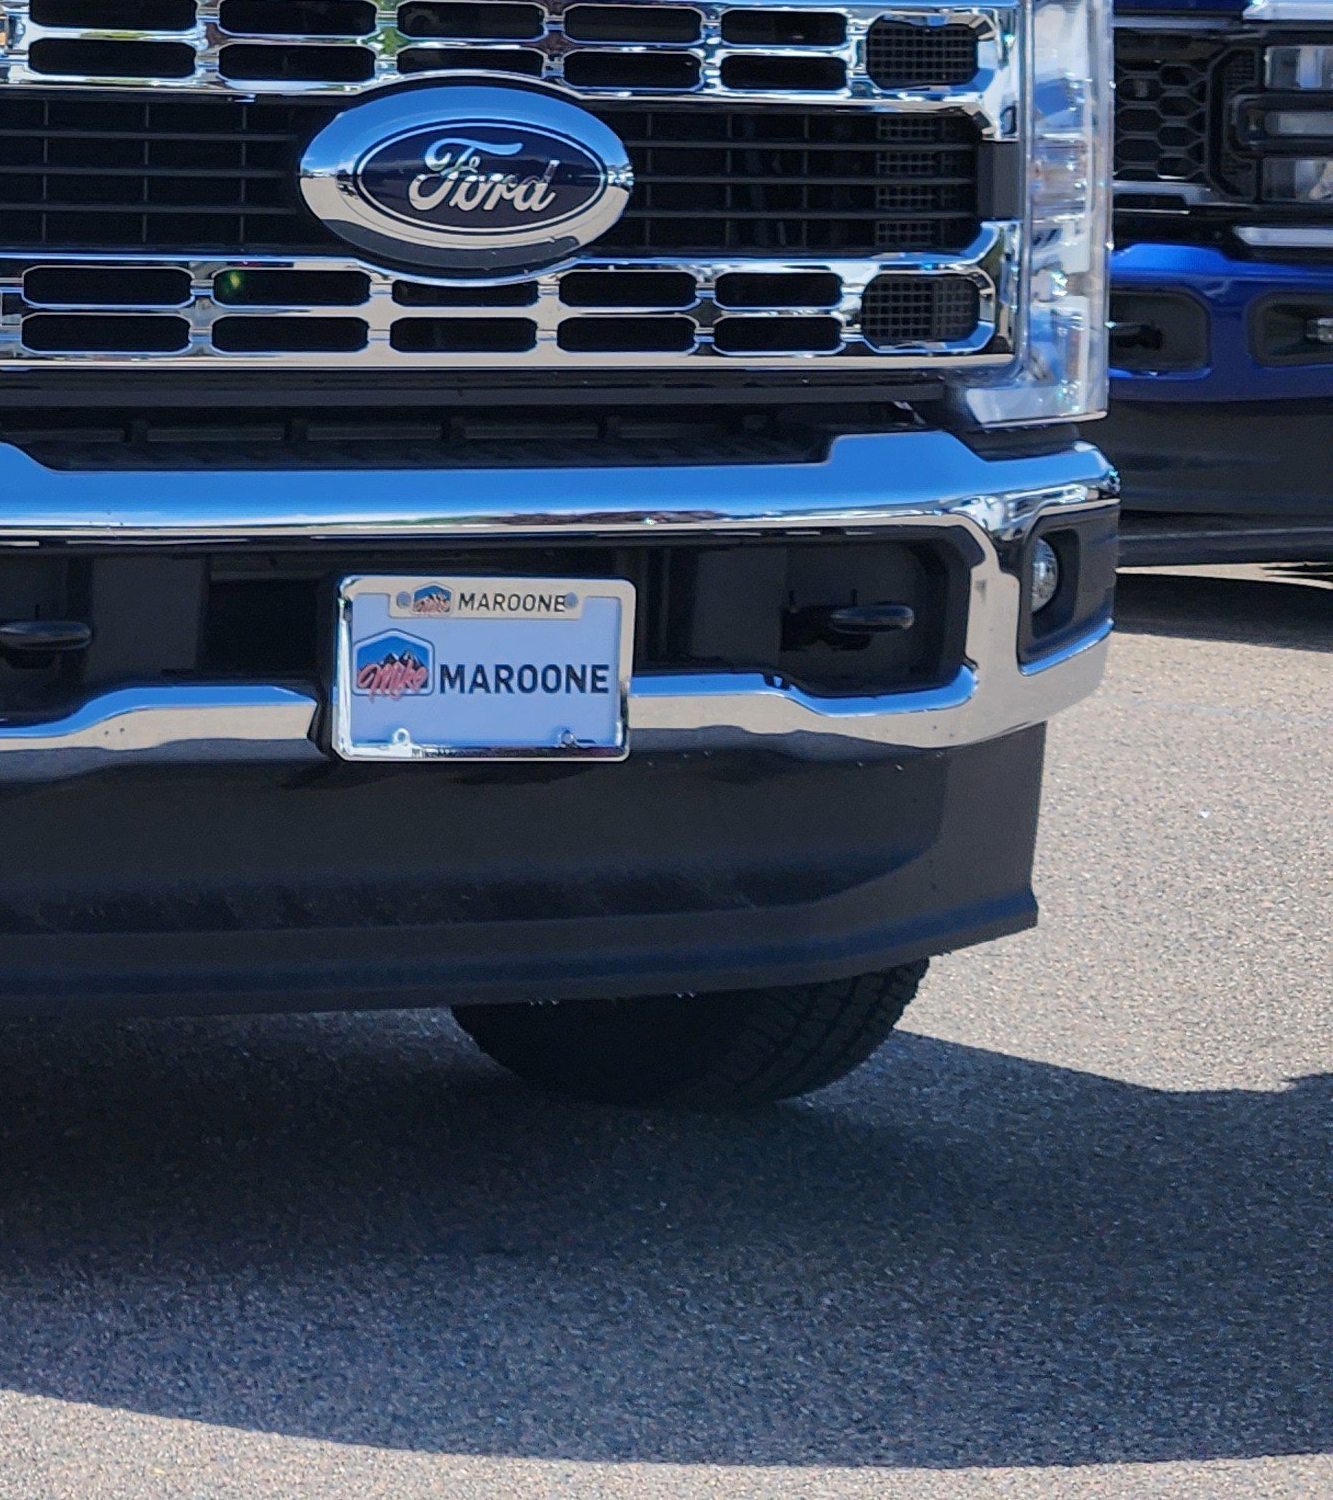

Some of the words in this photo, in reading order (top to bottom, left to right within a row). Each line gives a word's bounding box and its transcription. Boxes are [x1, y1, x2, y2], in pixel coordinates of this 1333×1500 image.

[408, 138, 561, 213] Ford
[458, 592, 567, 614] MAROONE
[357, 659, 429, 703] Mike
[438, 663, 610, 695] MAROONE
